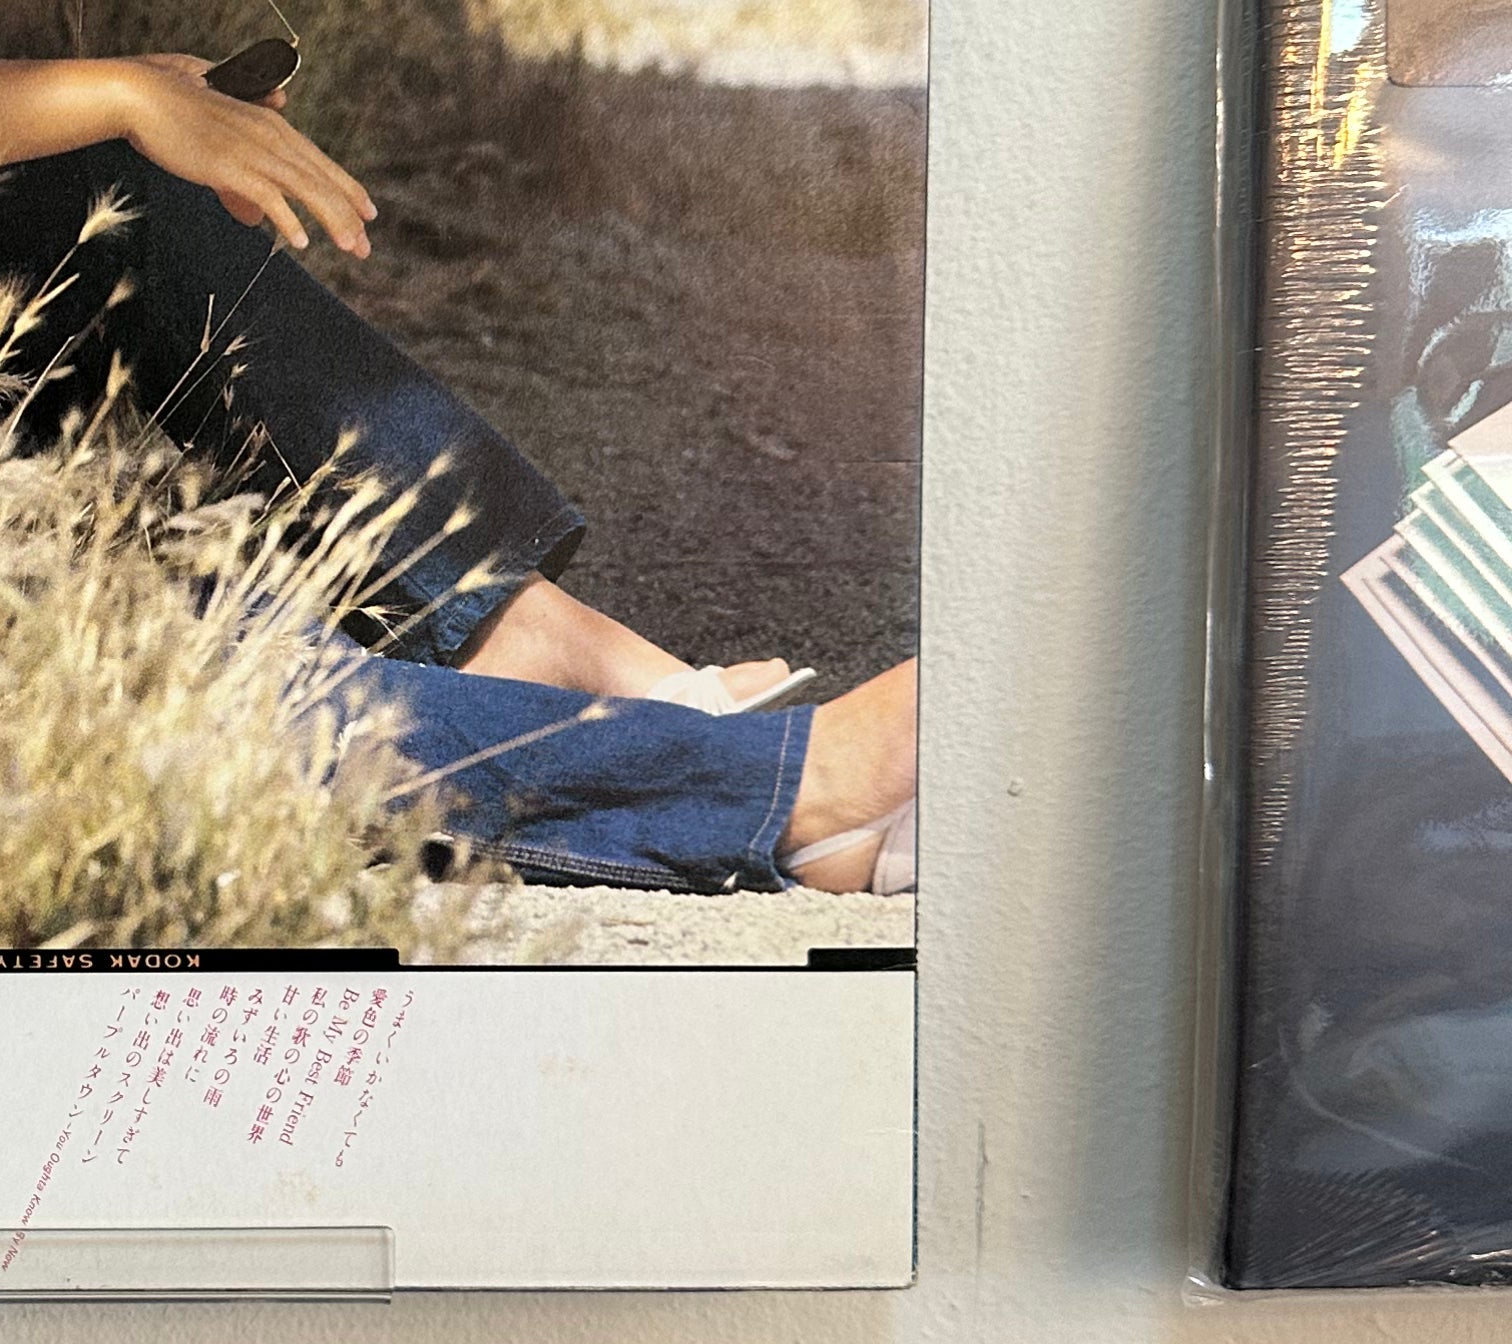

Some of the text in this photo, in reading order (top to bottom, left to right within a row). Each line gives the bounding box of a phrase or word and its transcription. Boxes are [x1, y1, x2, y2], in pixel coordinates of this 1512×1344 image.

[110, 953, 200, 968] KODAK
[184, 985, 238, 1083] 時の流れに
[203, 988, 264, 1108] みずいろの雨
[253, 984, 300, 1066] 甘い生活
[279, 987, 360, 1146] Be My Best Friend
[82, 989, 171, 1163] 想い出のスクリーン
[116, 987, 202, 1164] 思い出は美しすぎて
[335, 990, 414, 1167] うまくいかなくても
[21, 1193, 41, 1225] Know
[36, 1152, 61, 1191] Oughta
[1, 1246, 19, 1272] Now
